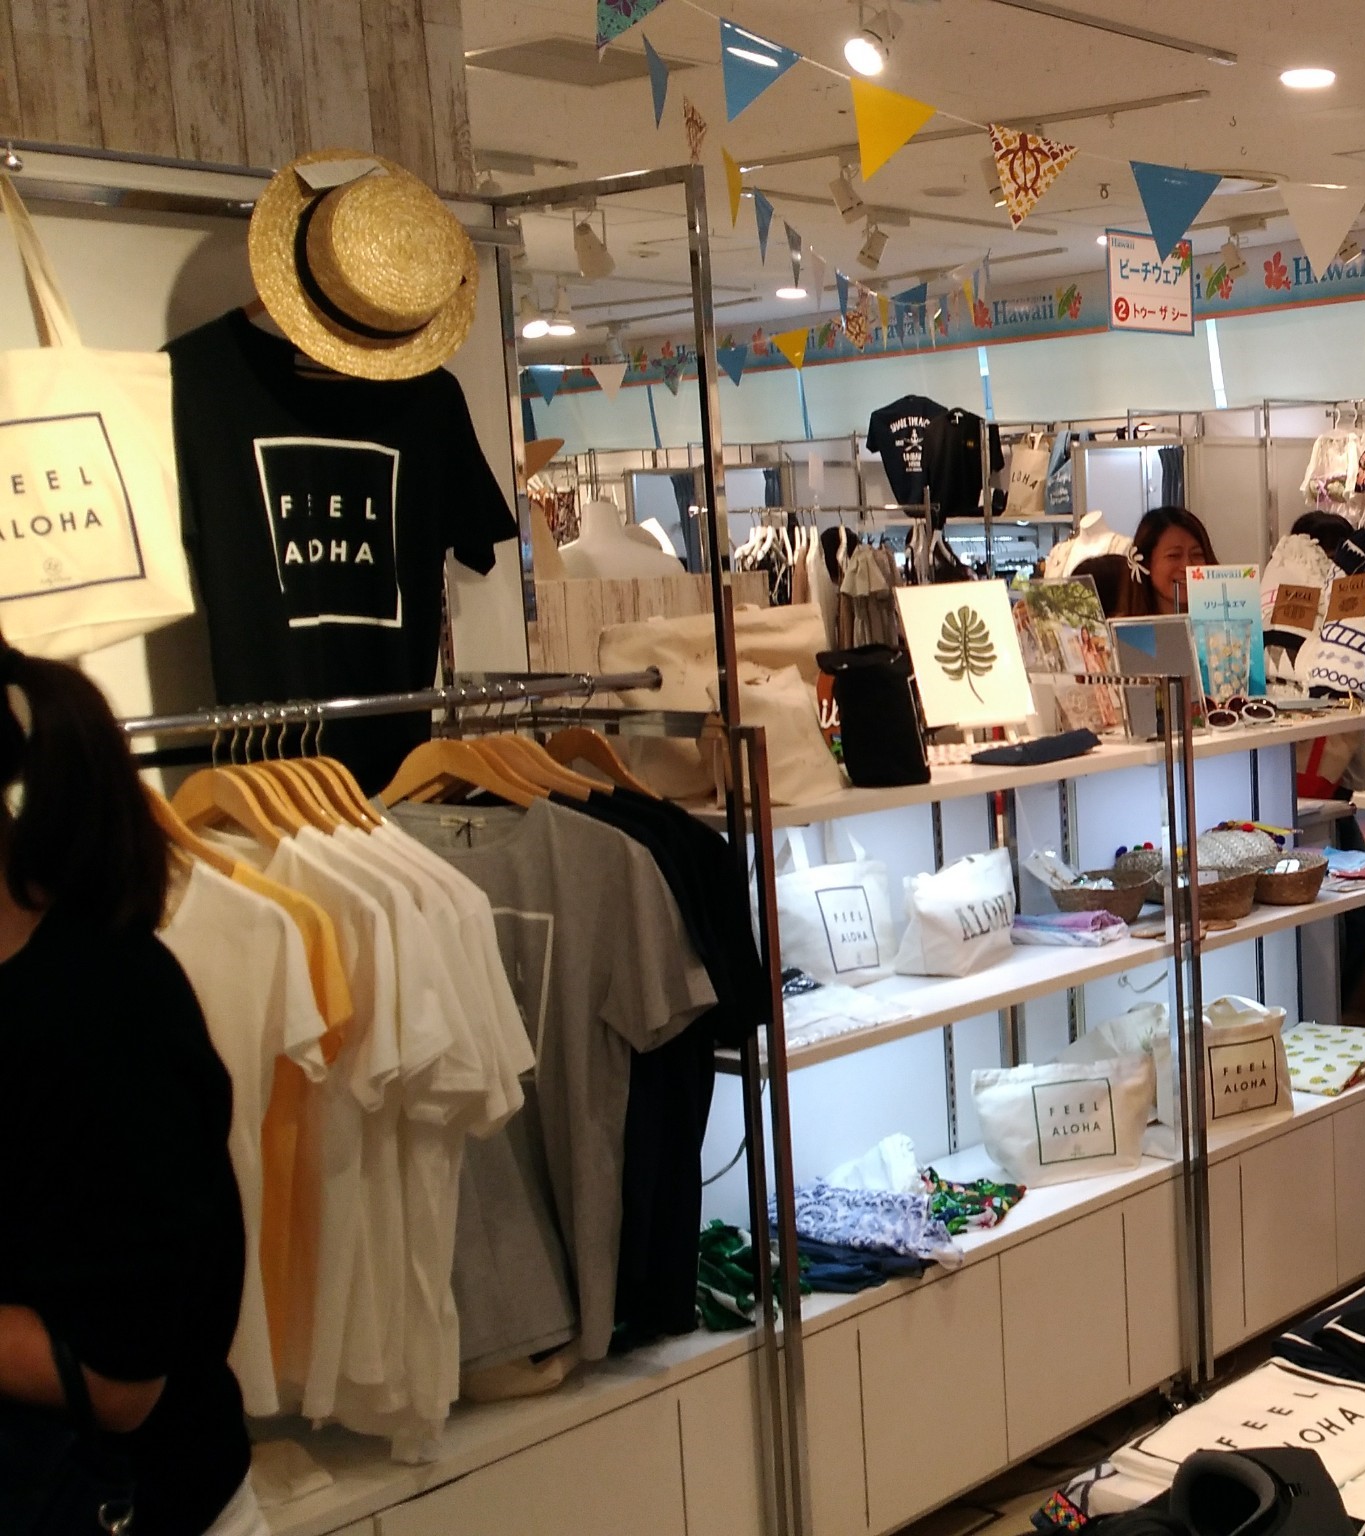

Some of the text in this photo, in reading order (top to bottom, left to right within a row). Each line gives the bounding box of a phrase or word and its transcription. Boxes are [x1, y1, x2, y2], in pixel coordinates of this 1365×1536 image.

[1119, 257, 1182, 287] ビーチウェア
[992, 295, 1056, 327] Hawaii
[1206, 568, 1242, 580] Hawaii
[833, 910, 863, 924] FEEL
[841, 930, 868, 944] ALOHA
[1223, 1059, 1267, 1077] FEEL
[1224, 1077, 1267, 1095] ALOHA
[1049, 1100, 1099, 1117] FEEL
[1052, 1120, 1102, 1137] ALOHA
[1214, 1391, 1319, 1450] FEEL
[1283, 1406, 1365, 1450] OHA
